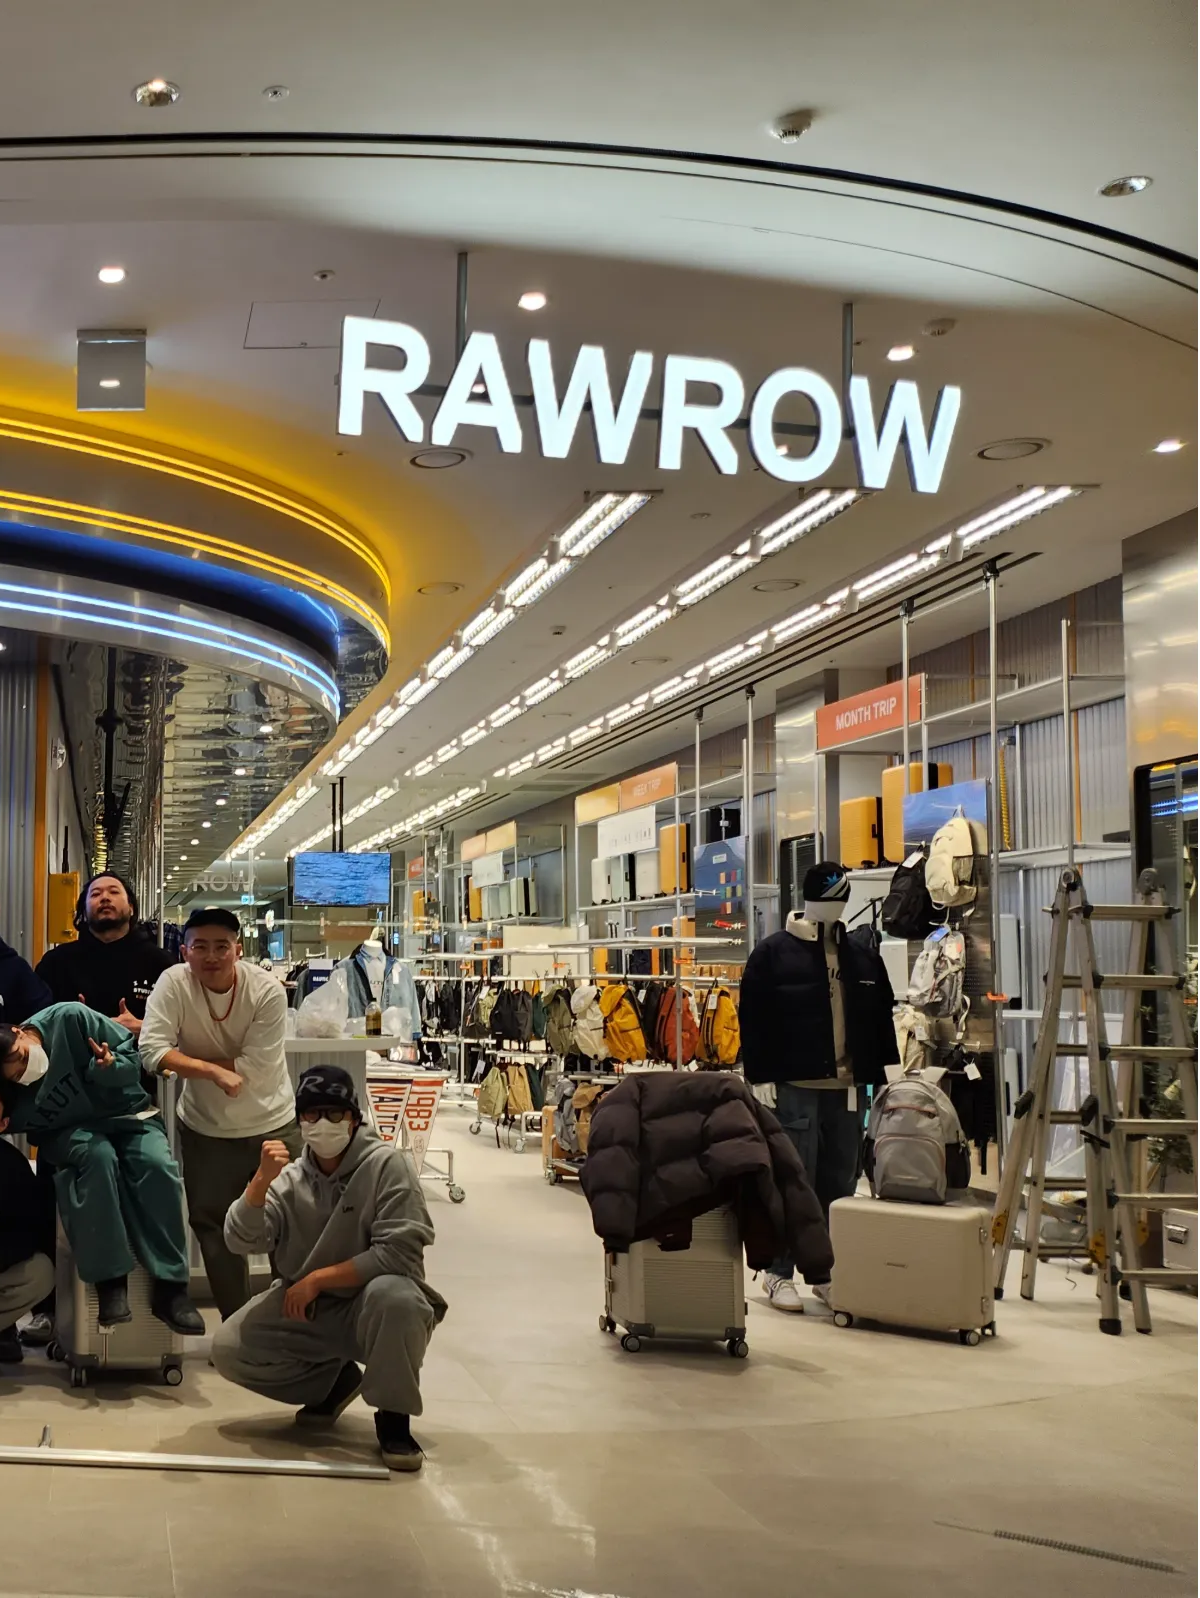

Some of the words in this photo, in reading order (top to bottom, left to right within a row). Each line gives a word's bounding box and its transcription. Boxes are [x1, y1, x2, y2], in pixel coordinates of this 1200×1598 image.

[337, 315, 962, 494] RAWROW
[835, 704, 871, 731] MONTH
[873, 696, 897, 719] TRIP
[368, 1085, 408, 1142] NAUTICA
[405, 1090, 437, 1132] 1983
